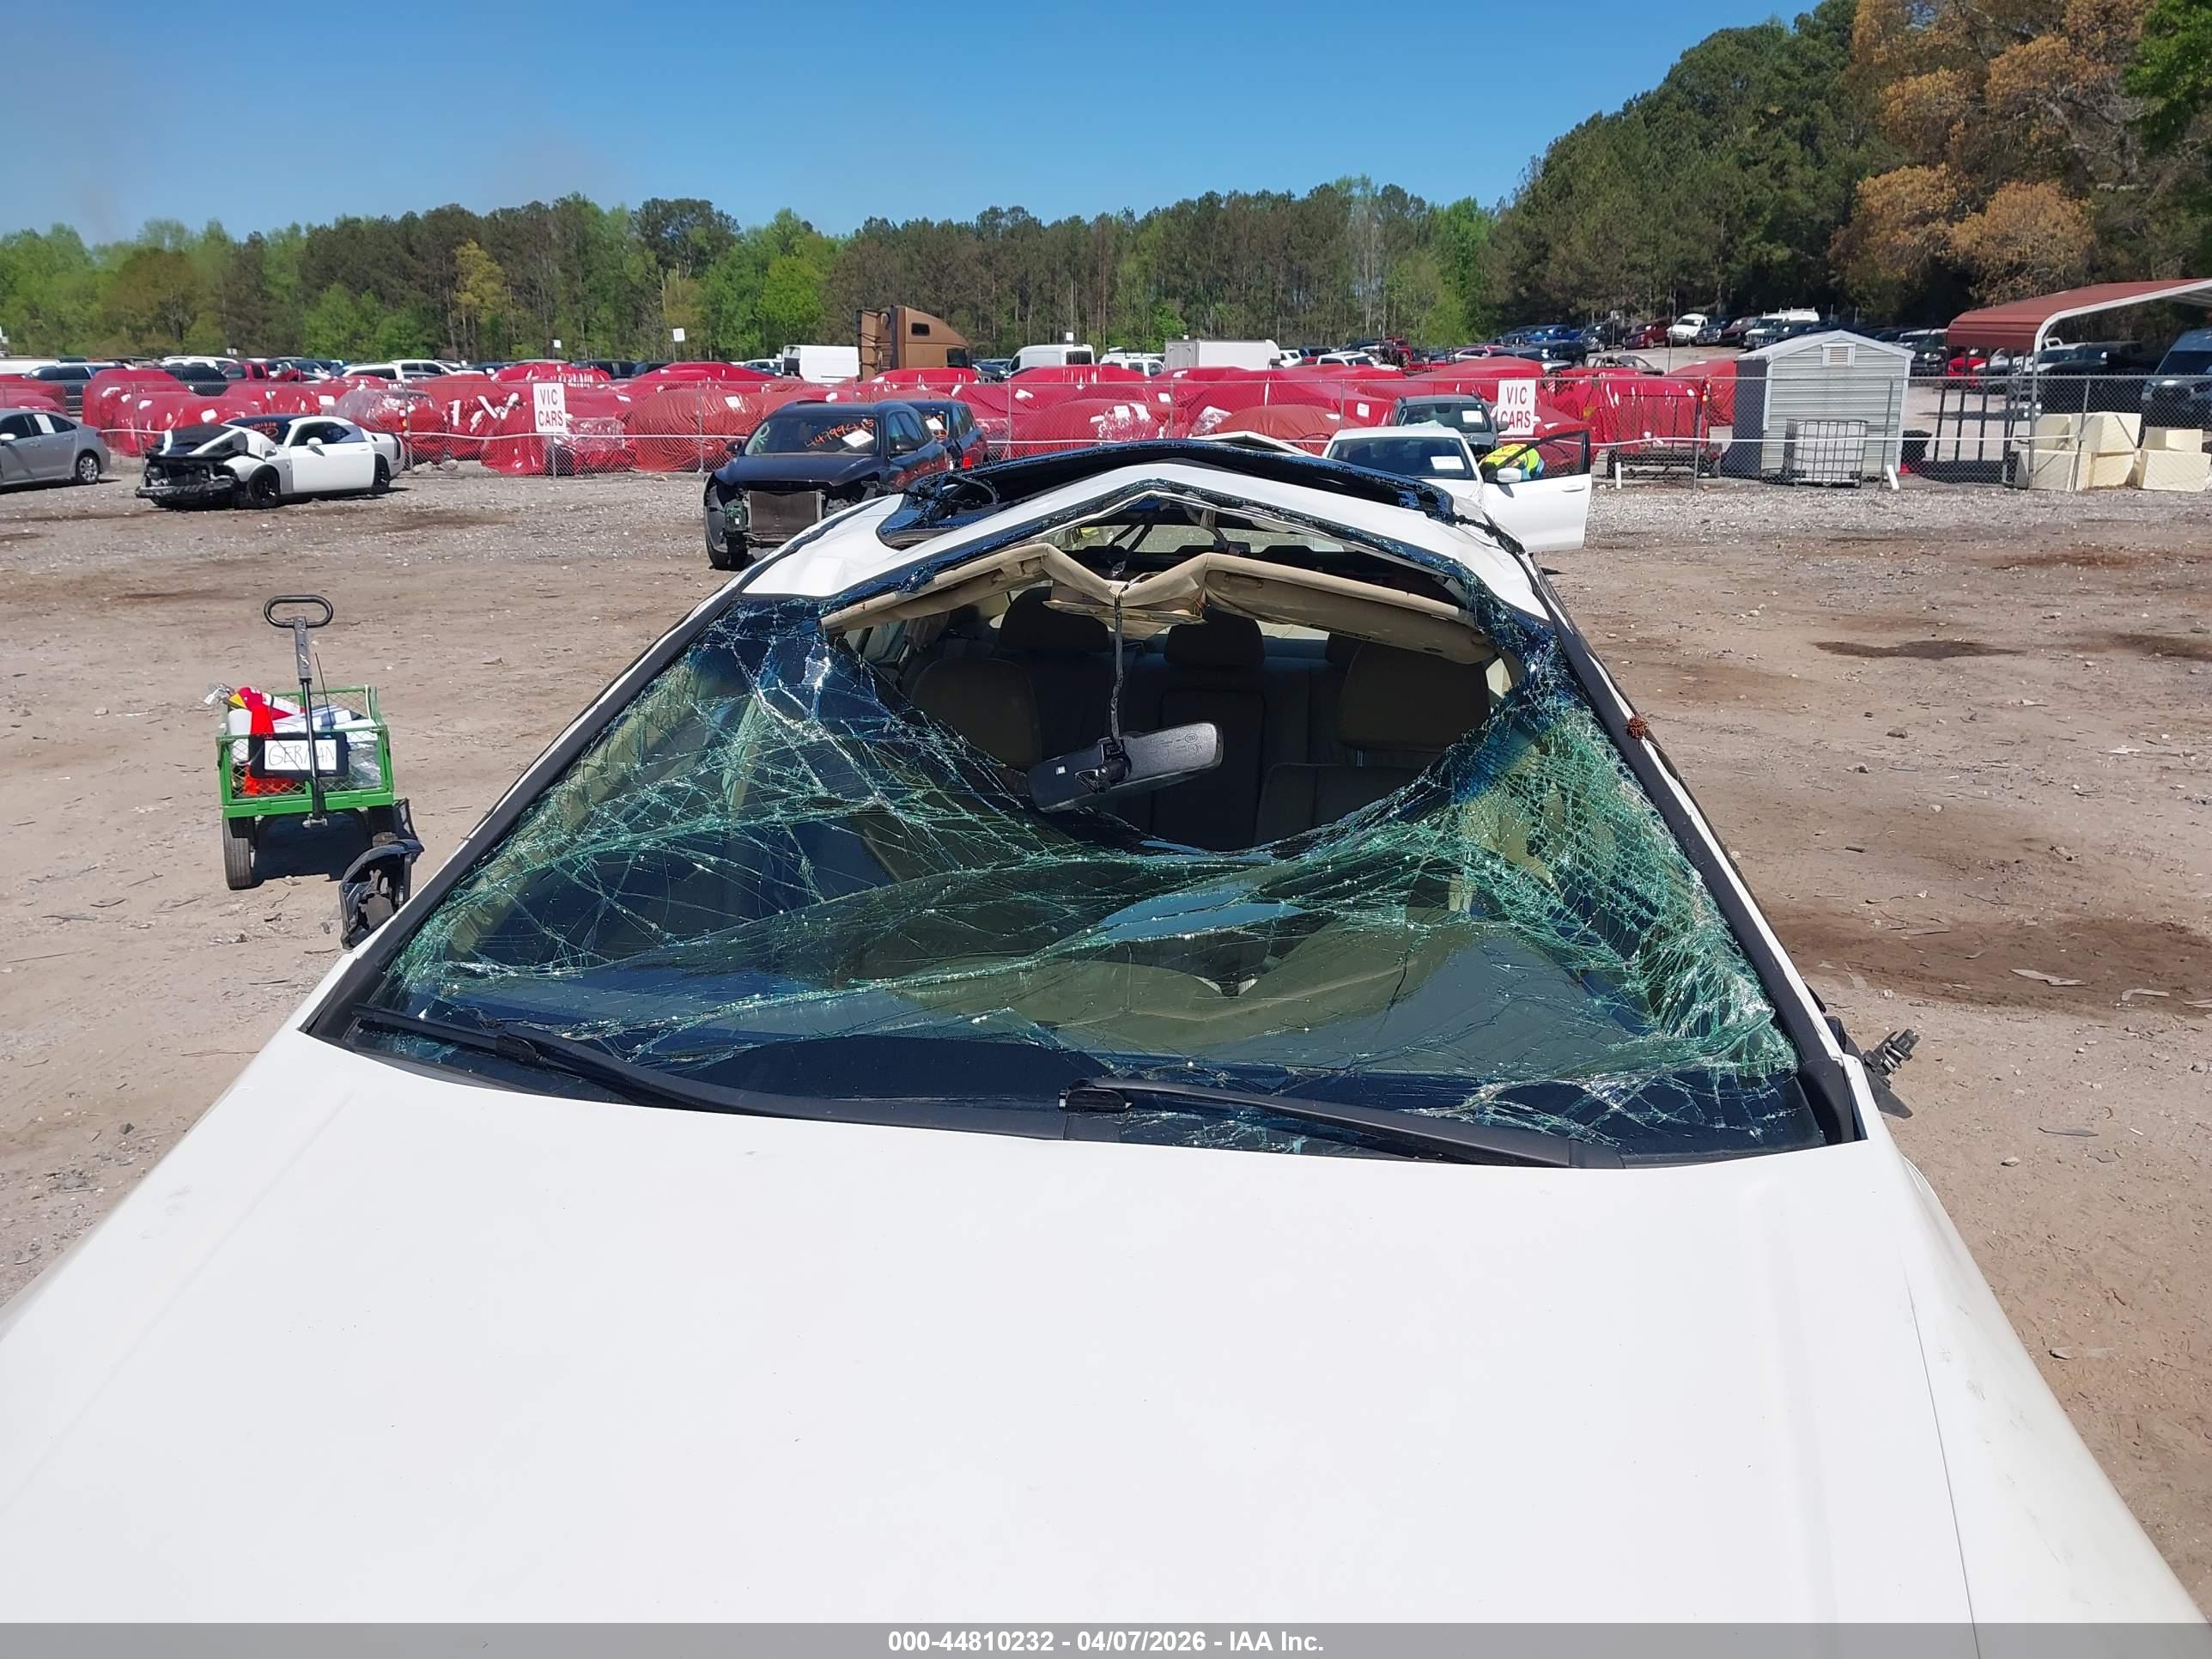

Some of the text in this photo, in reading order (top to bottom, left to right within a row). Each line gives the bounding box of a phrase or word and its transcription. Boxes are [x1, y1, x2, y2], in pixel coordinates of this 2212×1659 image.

[539, 389, 558, 405] VIC
[1506, 386, 1527, 404] VIC
[538, 410, 563, 427] CARS
[1500, 410, 1531, 428] CARS
